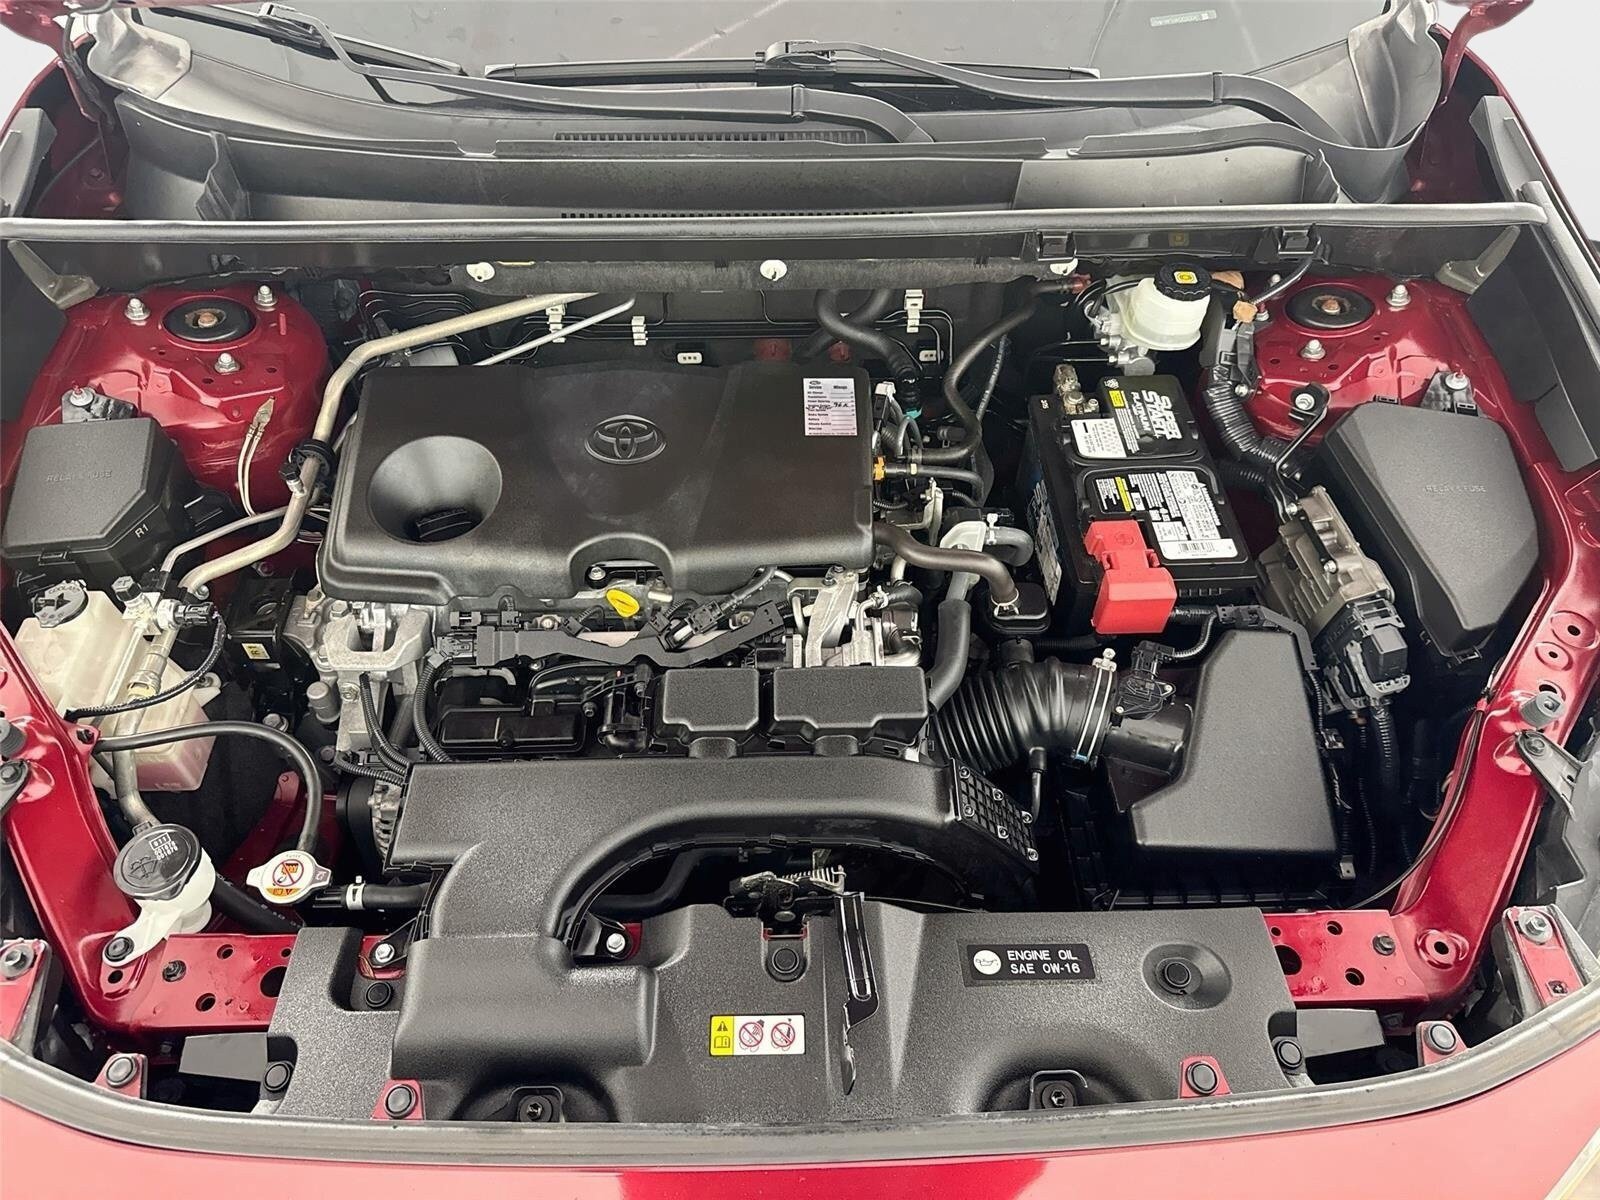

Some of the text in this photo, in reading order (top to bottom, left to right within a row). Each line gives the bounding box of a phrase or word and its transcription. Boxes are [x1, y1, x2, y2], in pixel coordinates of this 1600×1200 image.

[1131, 391, 1151, 431] PLATINUM
[1141, 390, 1166, 438] START
[1160, 395, 1182, 440] SUPER
[134, 523, 149, 539] R1
[1006, 949, 1078, 961] ENGINE OIL
[1010, 963, 1081, 974] SAE 0W-16
